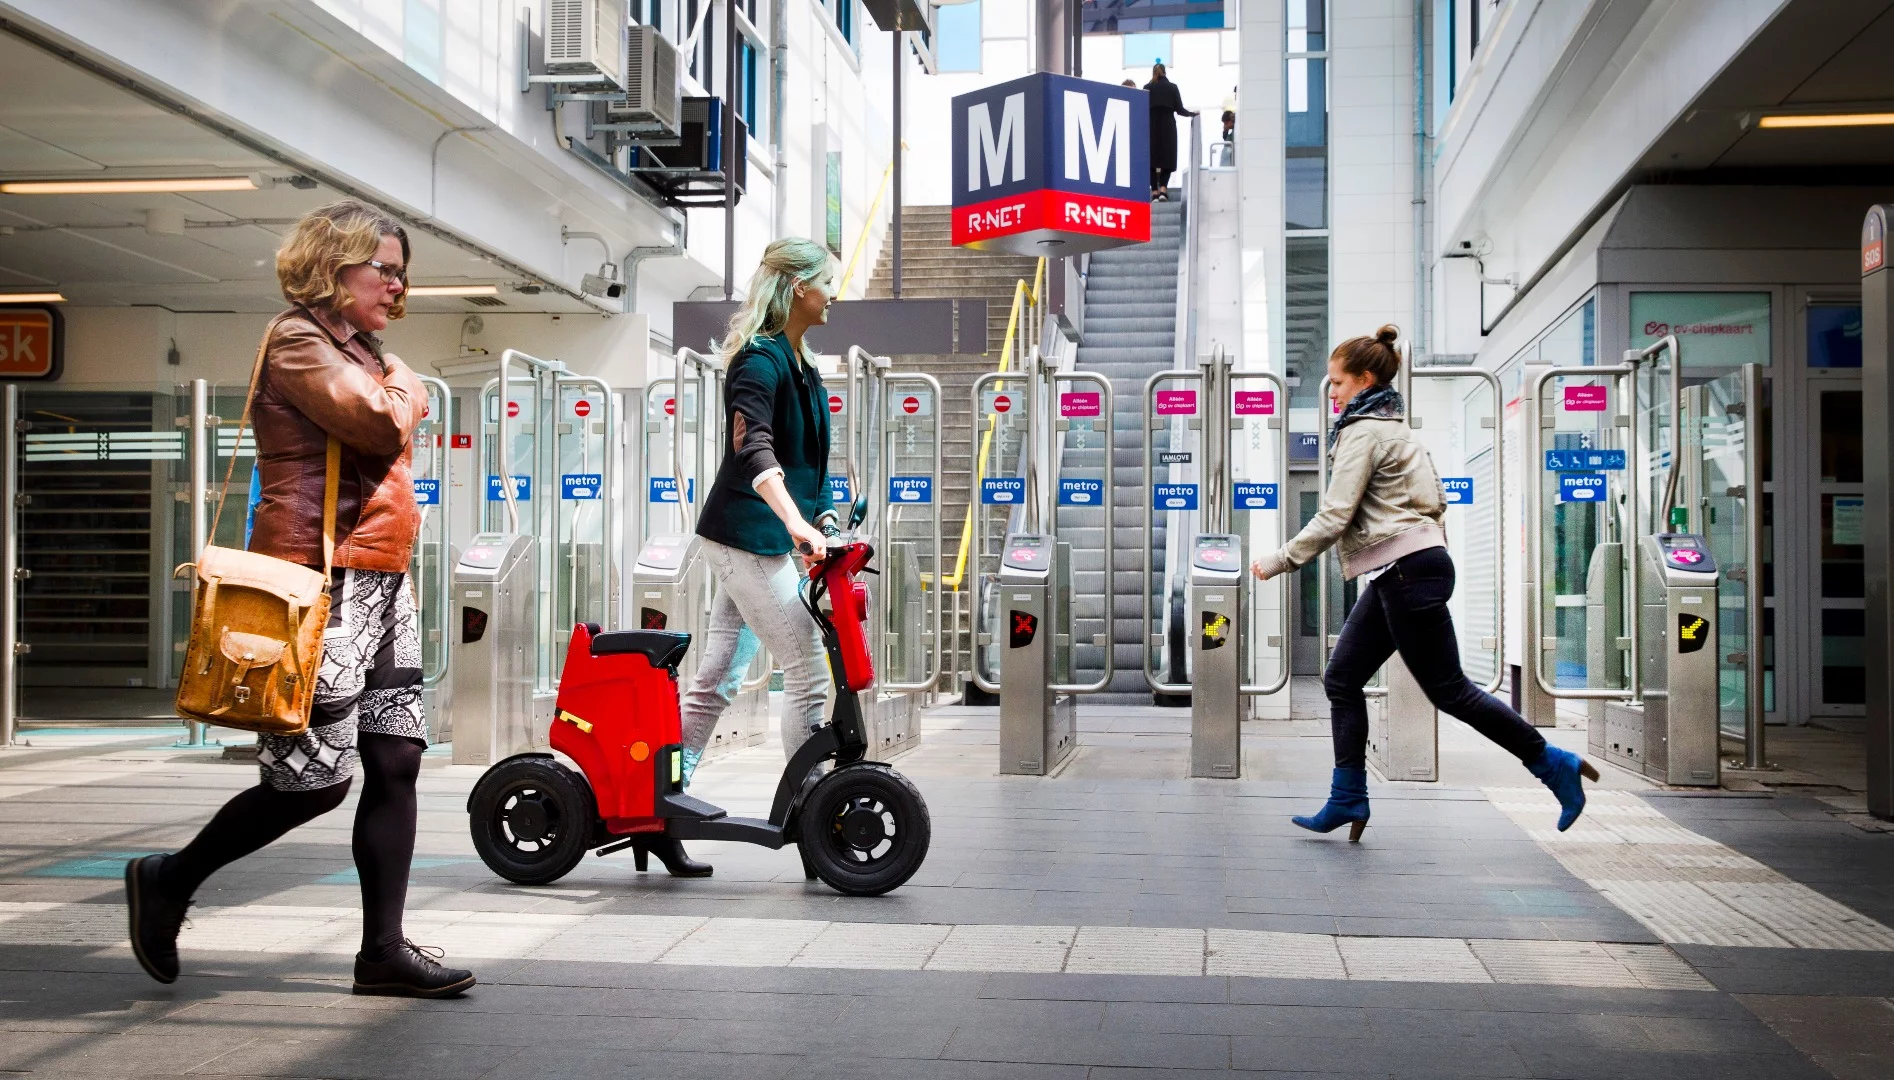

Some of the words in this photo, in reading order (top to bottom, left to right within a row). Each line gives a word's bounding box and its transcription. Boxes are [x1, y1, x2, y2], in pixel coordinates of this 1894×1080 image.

[968, 92, 1026, 192] M
[1064, 90, 1131, 188] M
[1864, 246, 1880, 268] SOS
[460, 437, 468, 445] M
[1302, 436, 1317, 445] Lift
[414, 481, 436, 490] etro
[565, 476, 598, 486] metro
[893, 479, 928, 489] metro
[985, 480, 1021, 490] metro
[1062, 481, 1099, 491] metro
[1443, 480, 1469, 490] etro
[1564, 476, 1603, 487] metro
[1158, 486, 1194, 495] metro
[1237, 485, 1274, 495] metro
